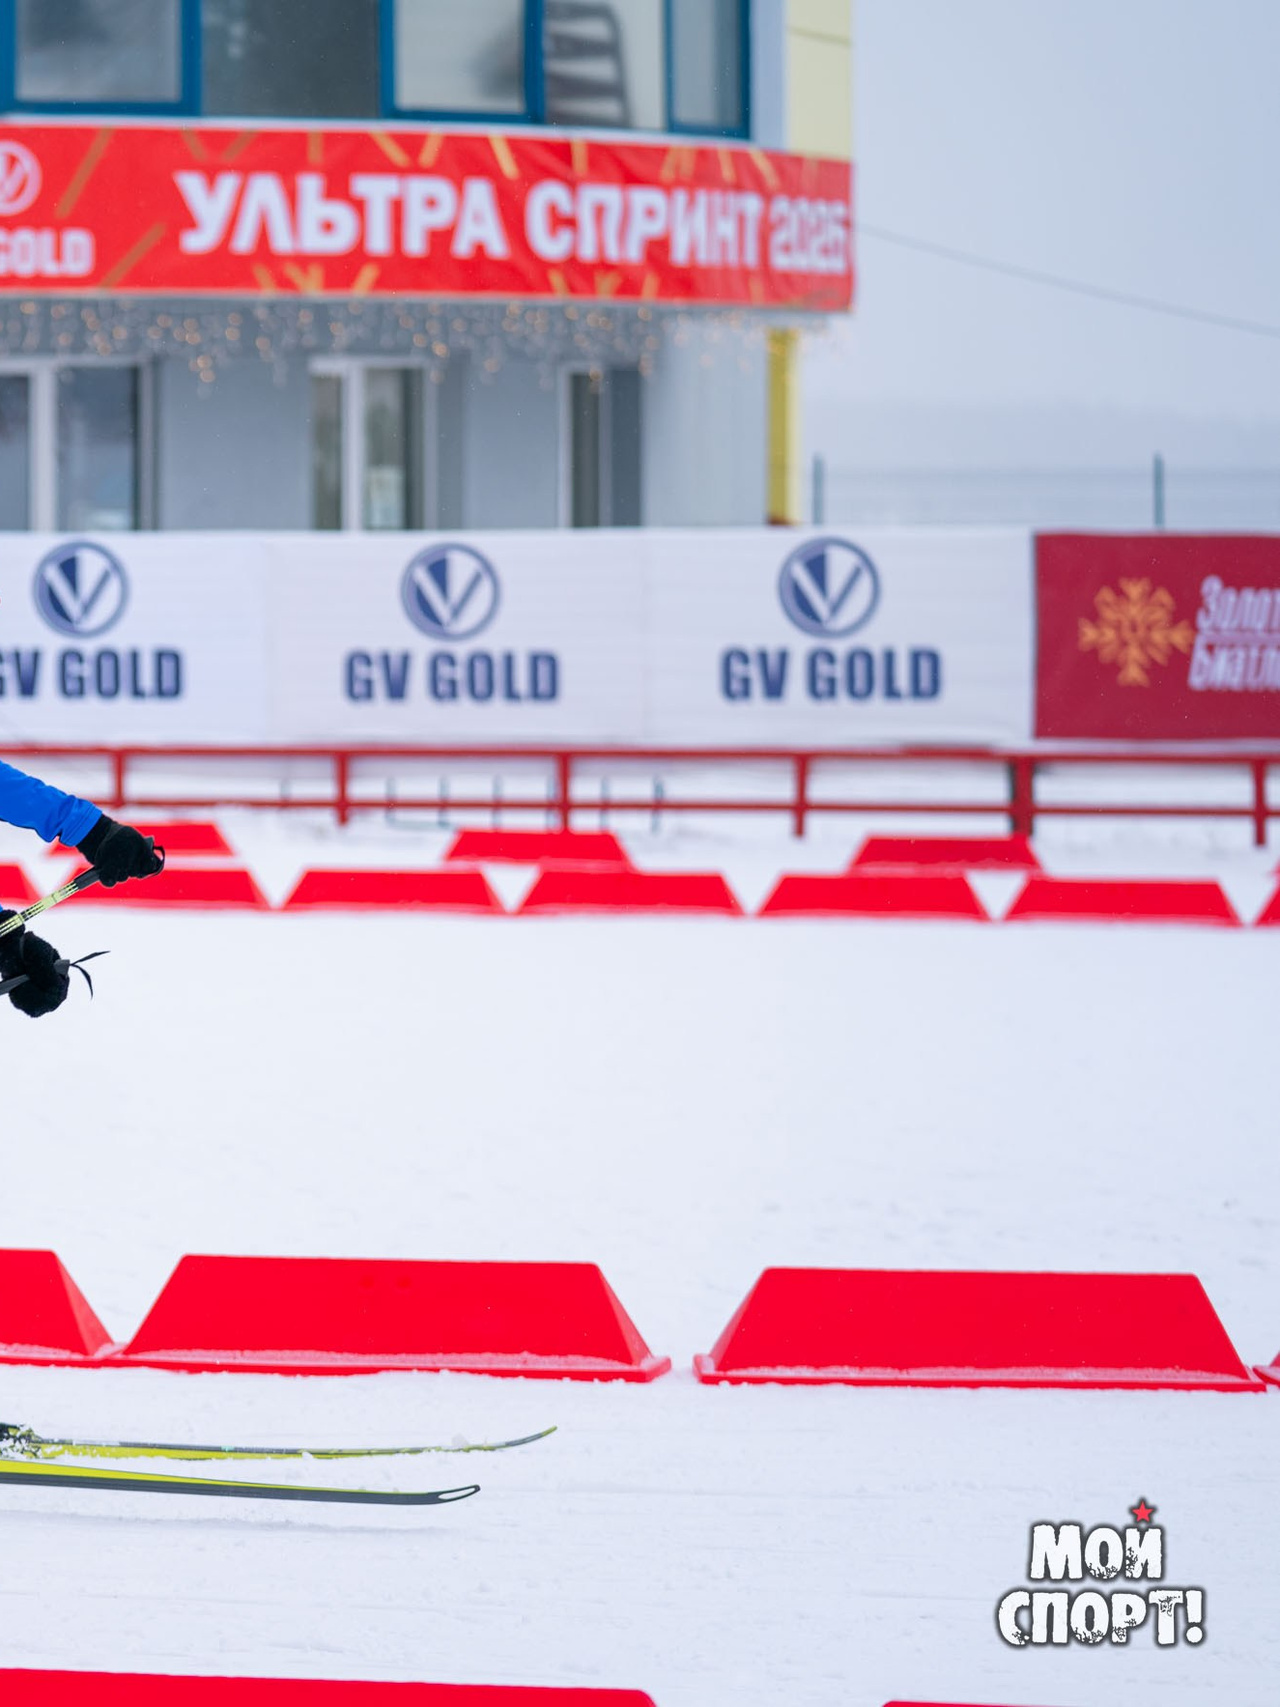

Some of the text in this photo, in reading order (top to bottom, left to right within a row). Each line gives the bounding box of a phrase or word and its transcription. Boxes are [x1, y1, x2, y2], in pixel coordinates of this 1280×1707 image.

[175, 171, 847, 274] УЛЬТРА СПРИНТ 2025
[60, 647, 183, 699] GOLD
[345, 650, 560, 702] GV GOLD
[721, 646, 942, 701] GV GOLD
